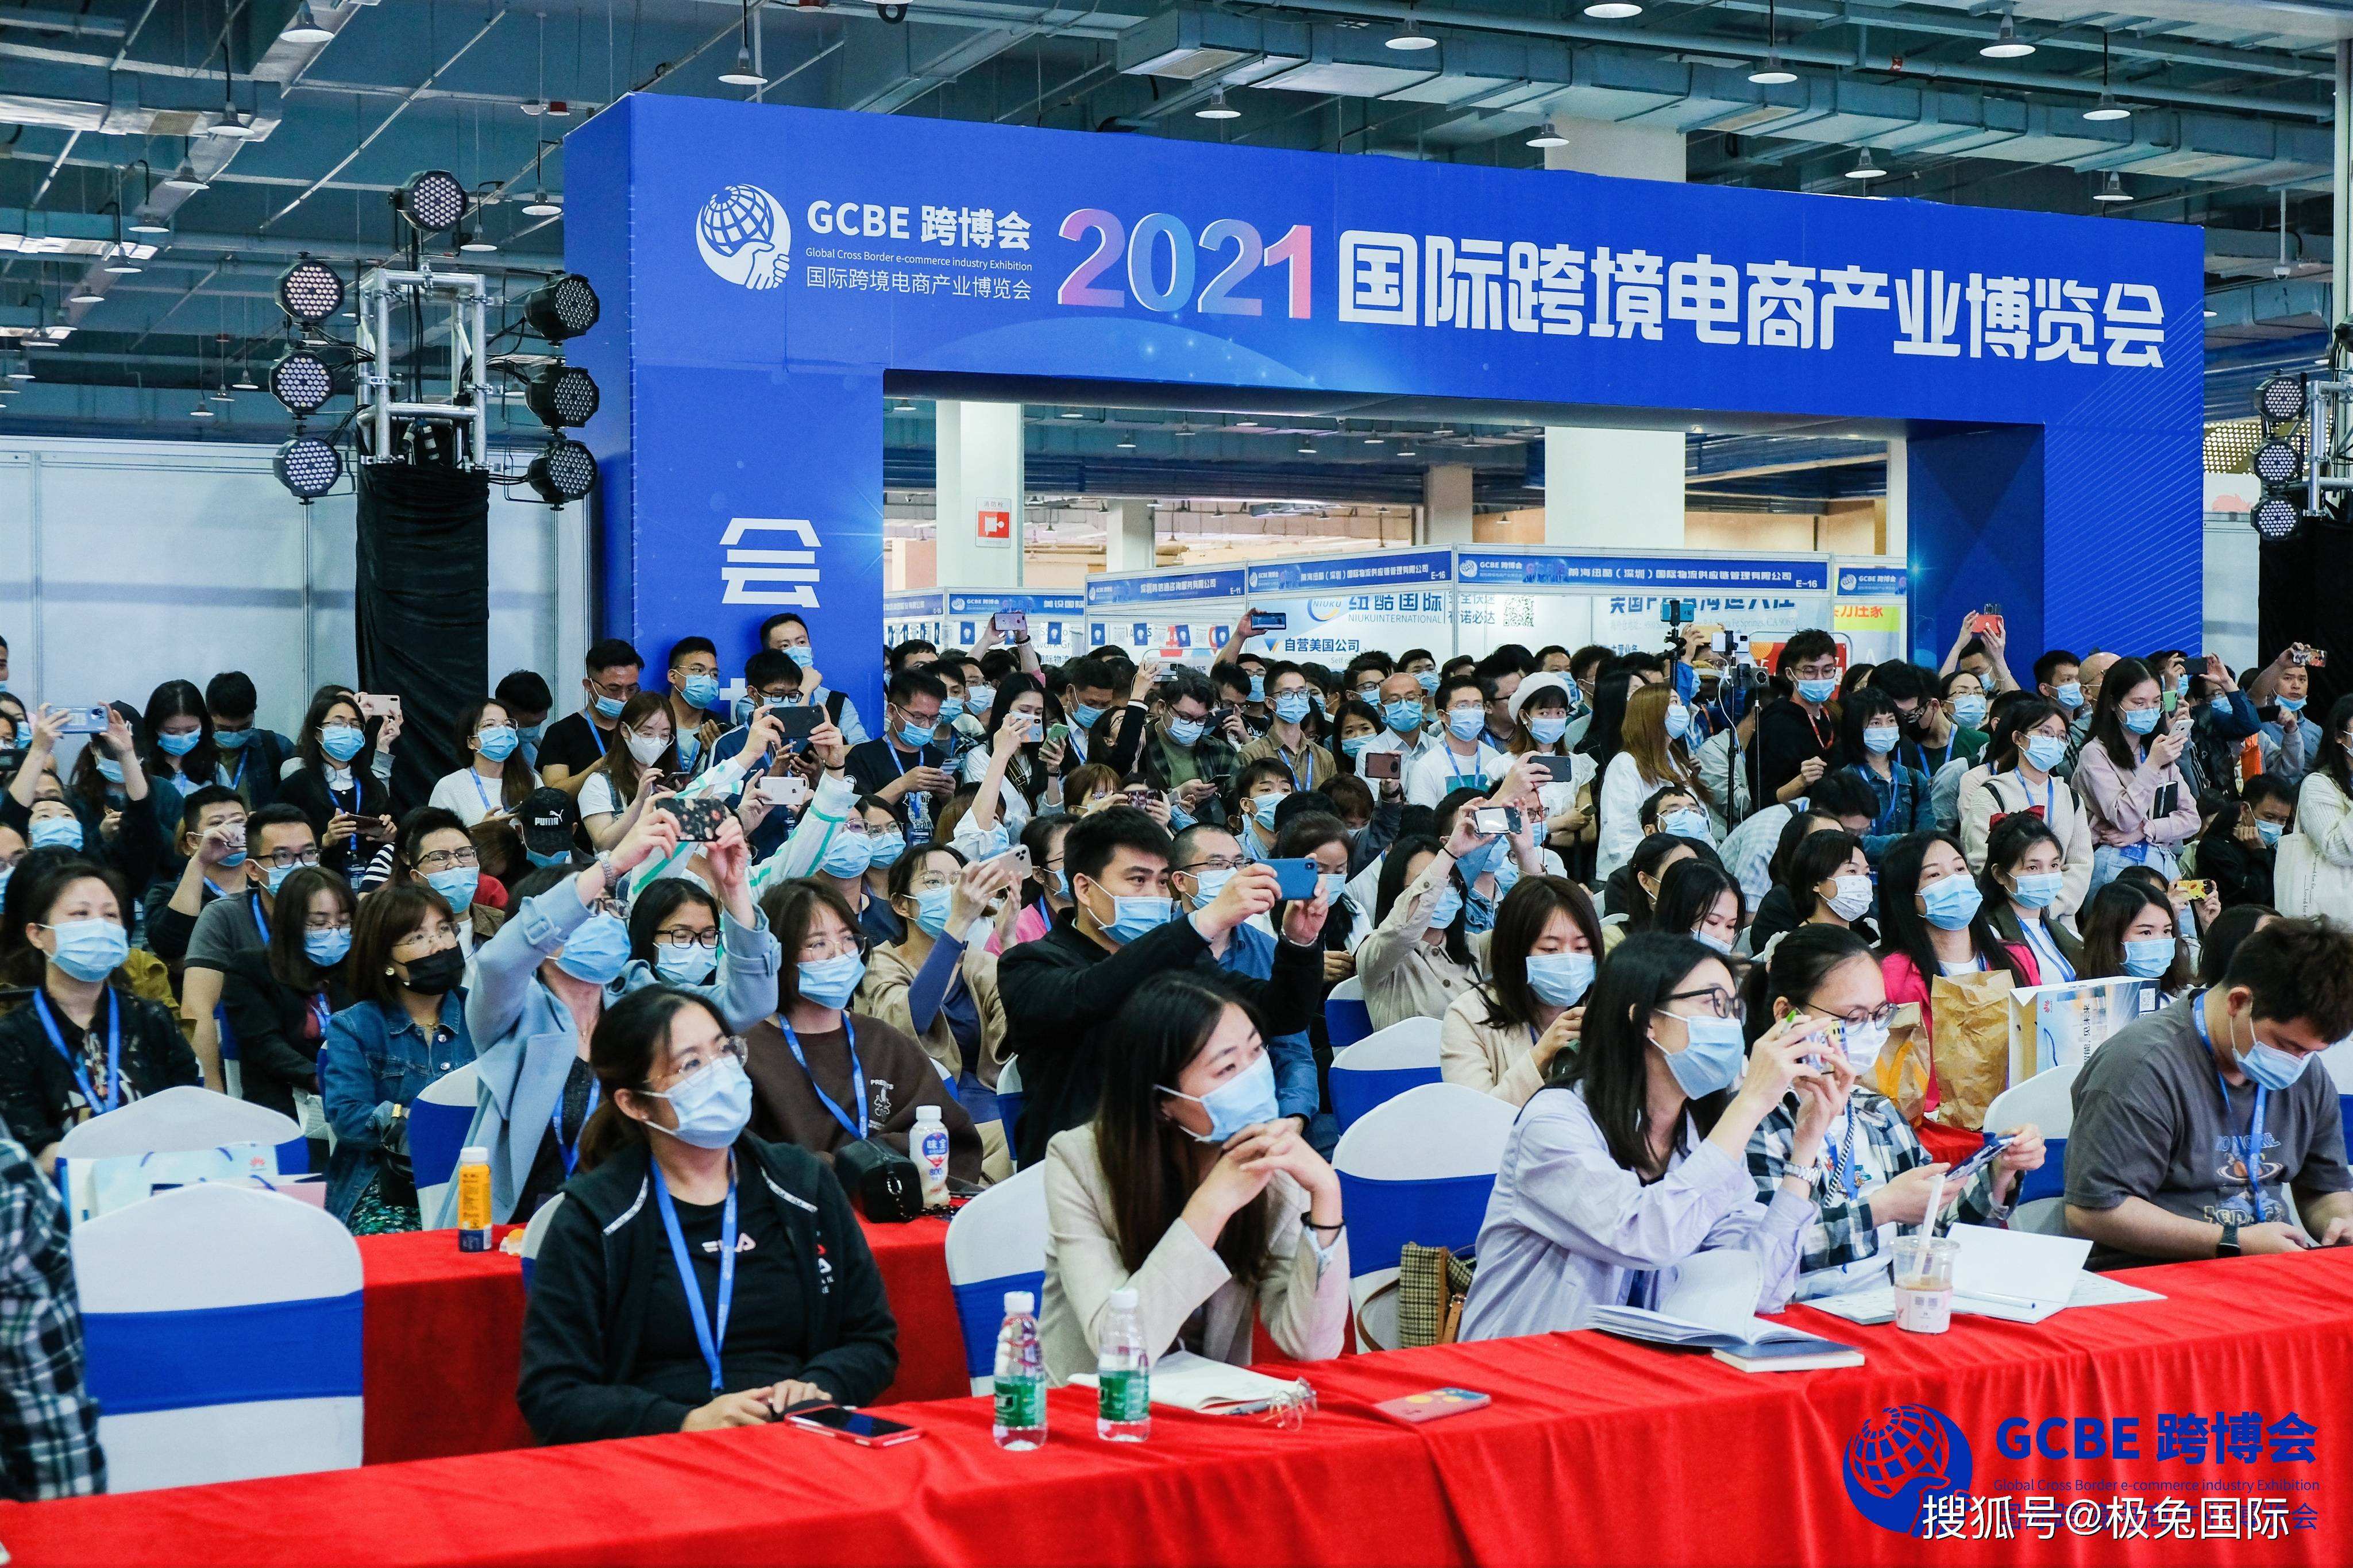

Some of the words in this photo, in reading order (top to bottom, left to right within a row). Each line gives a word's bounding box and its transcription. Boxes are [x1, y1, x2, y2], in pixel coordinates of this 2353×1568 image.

[807, 200, 910, 240] GCBE
[920, 205, 1032, 251] 跨博会
[806, 248, 835, 258] Global
[837, 250, 862, 260] Cross
[864, 251, 894, 262] Border
[896, 255, 951, 266] e-commerce
[952, 257, 988, 271] industry
[990, 260, 1032, 272] Exhibition
[1058, 207, 1311, 319] 2021
[807, 265, 1032, 300] 国际跨境电商产业博览会
[1337, 229, 2165, 368] 国际跨境电商产业博览会
[719, 517, 822, 608] 会
[1500, 561, 1522, 570] 跨博会
[1430, 571, 1446, 580] E-16
[1229, 586, 1241, 595] E-11
[1796, 580, 1818, 588] E-16
[1313, 600, 1341, 608] NIUKU
[1284, 638, 1360, 652] 自营美国公司
[535, 817, 559, 826] PUMA
